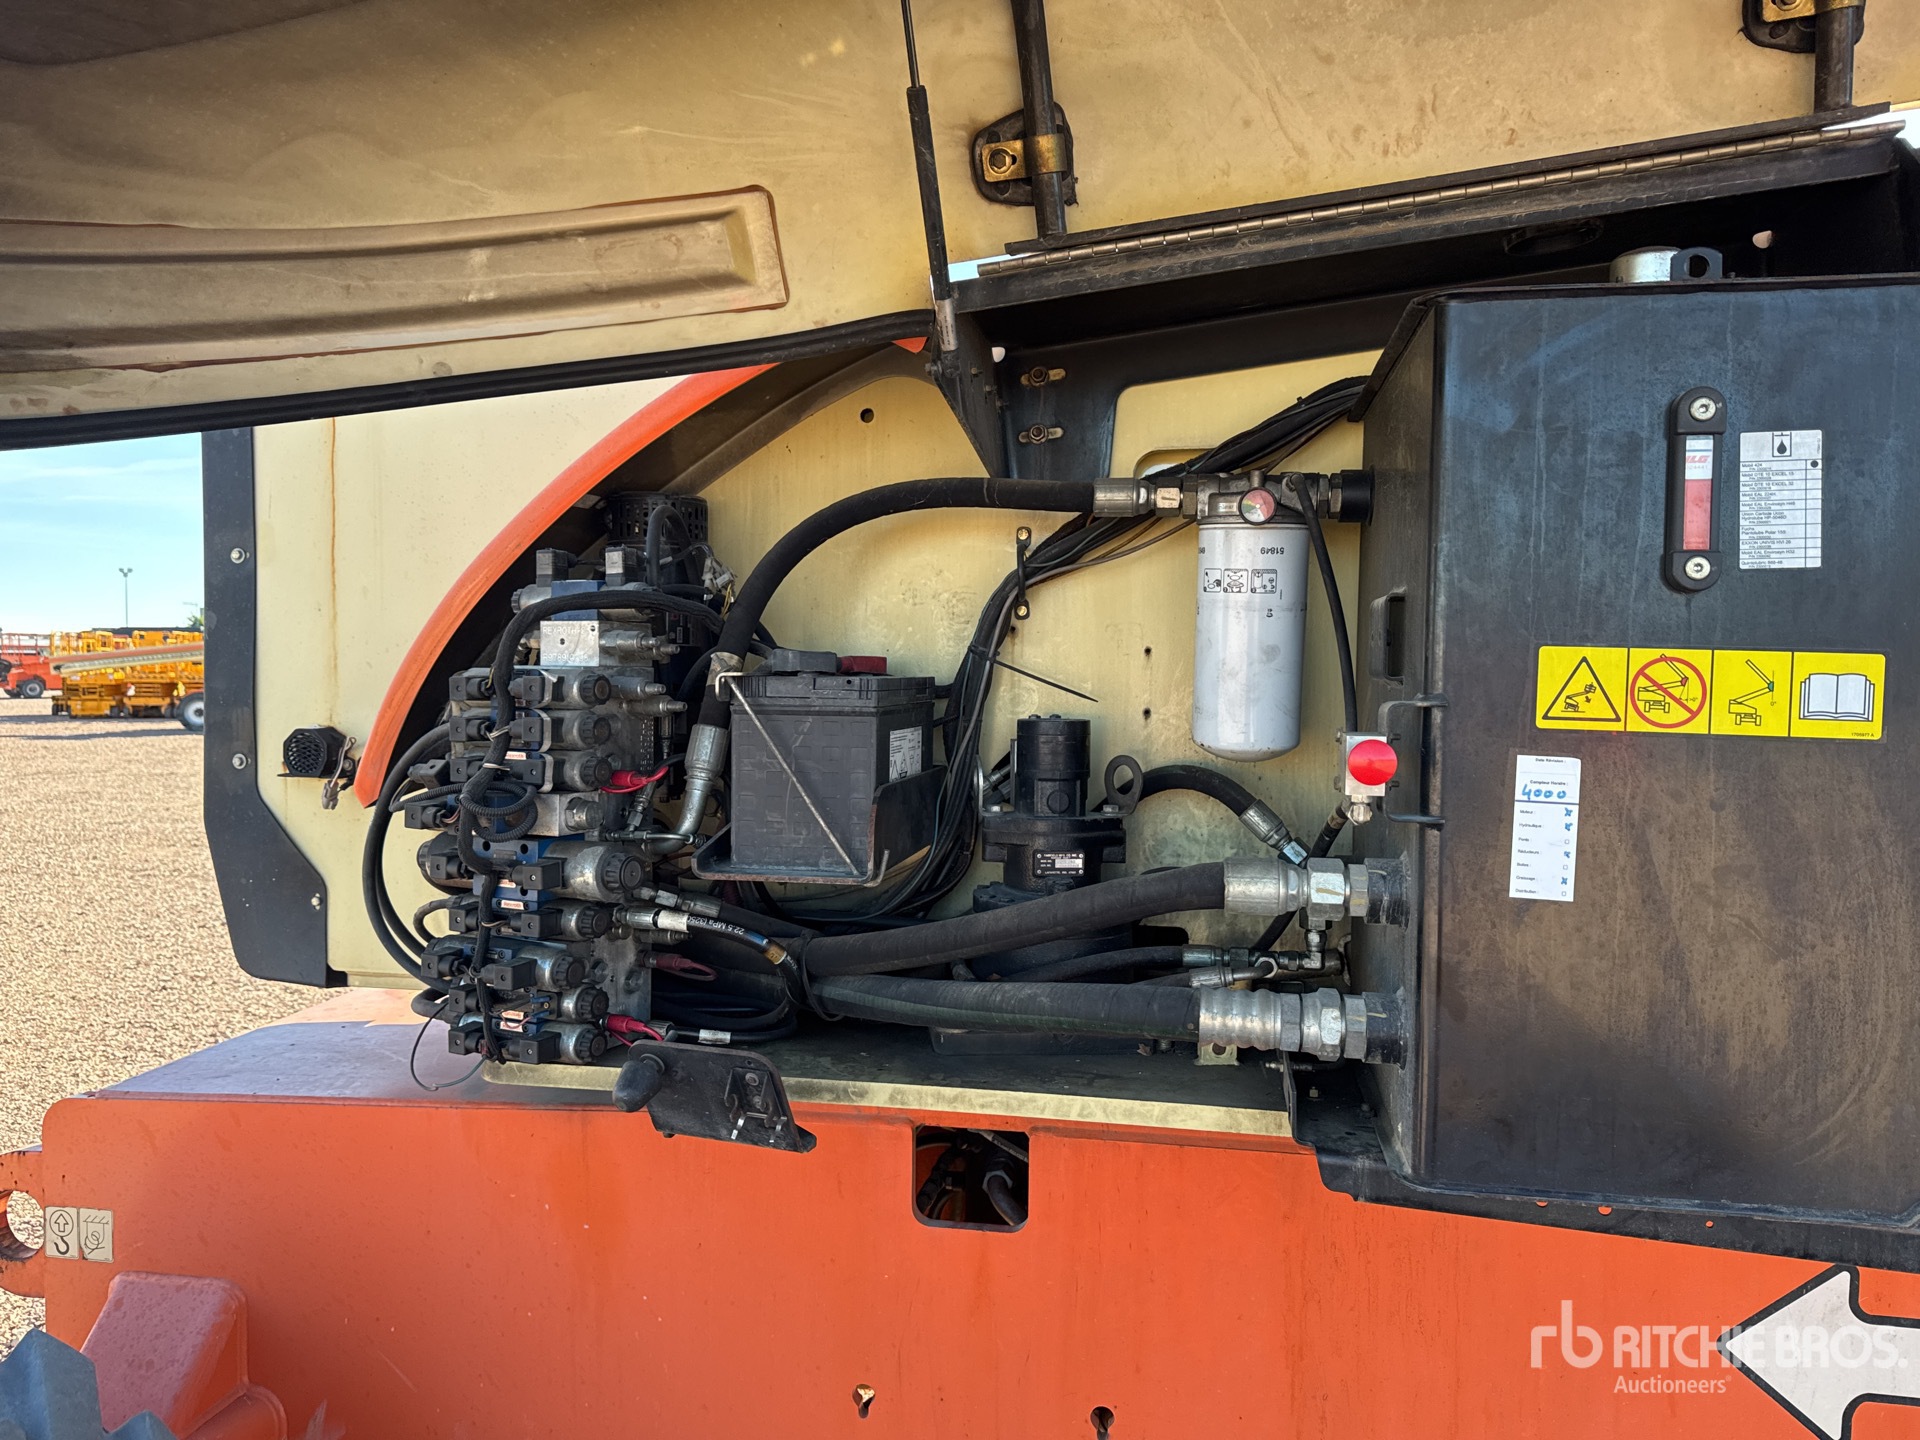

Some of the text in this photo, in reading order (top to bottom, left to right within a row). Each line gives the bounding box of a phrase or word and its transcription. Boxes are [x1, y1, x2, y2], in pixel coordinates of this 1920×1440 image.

[1521, 783, 1567, 800] 4000
[709, 919, 727, 930] MPa
[727, 924, 744, 935] 22.5
